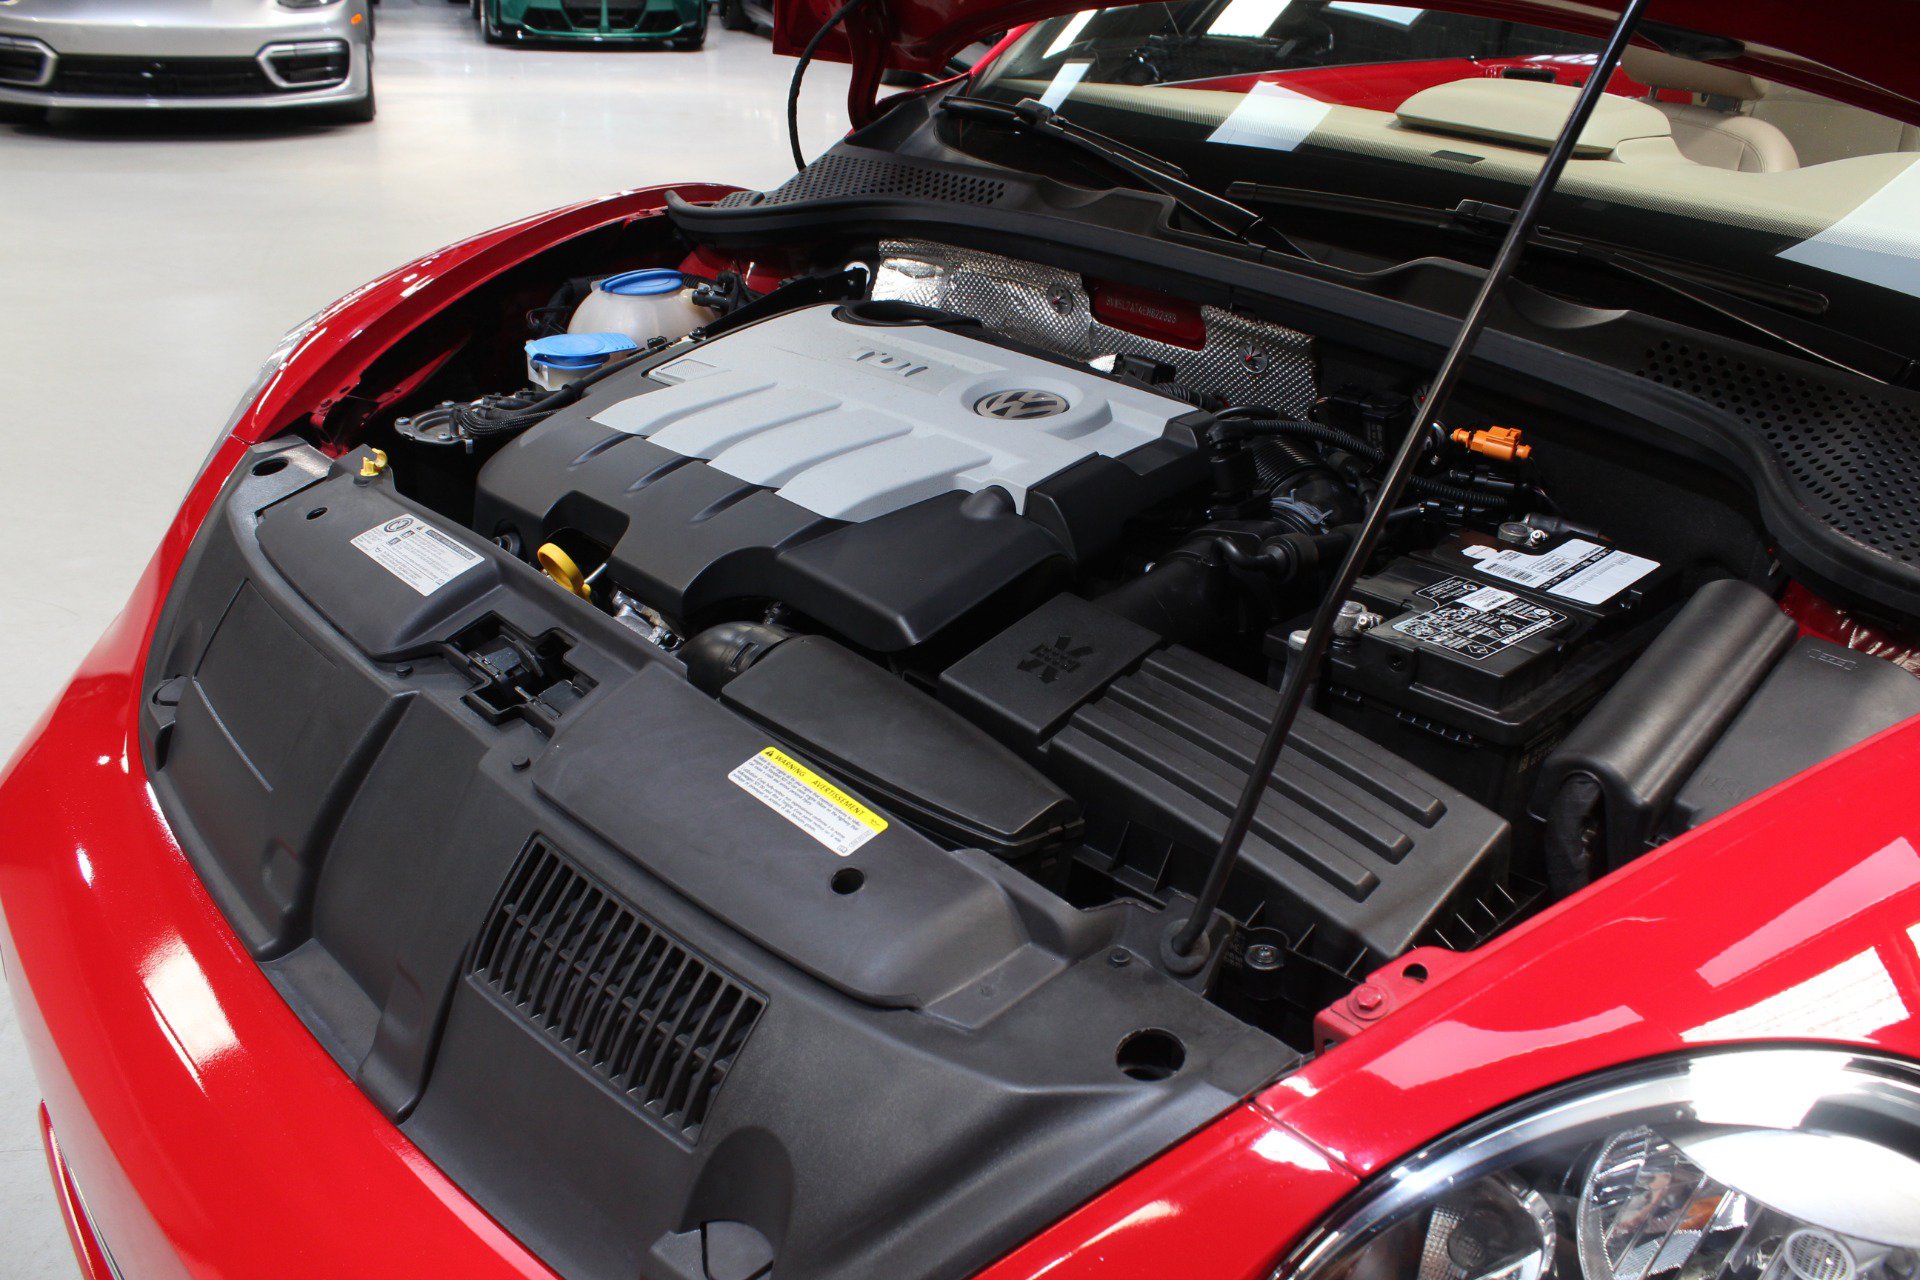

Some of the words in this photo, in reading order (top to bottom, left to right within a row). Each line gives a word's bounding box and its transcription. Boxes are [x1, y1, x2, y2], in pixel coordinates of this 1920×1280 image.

[851, 350, 928, 377] TDI
[774, 754, 807, 777] WARNING
[811, 779, 865, 816] AVERTISSEMENT
